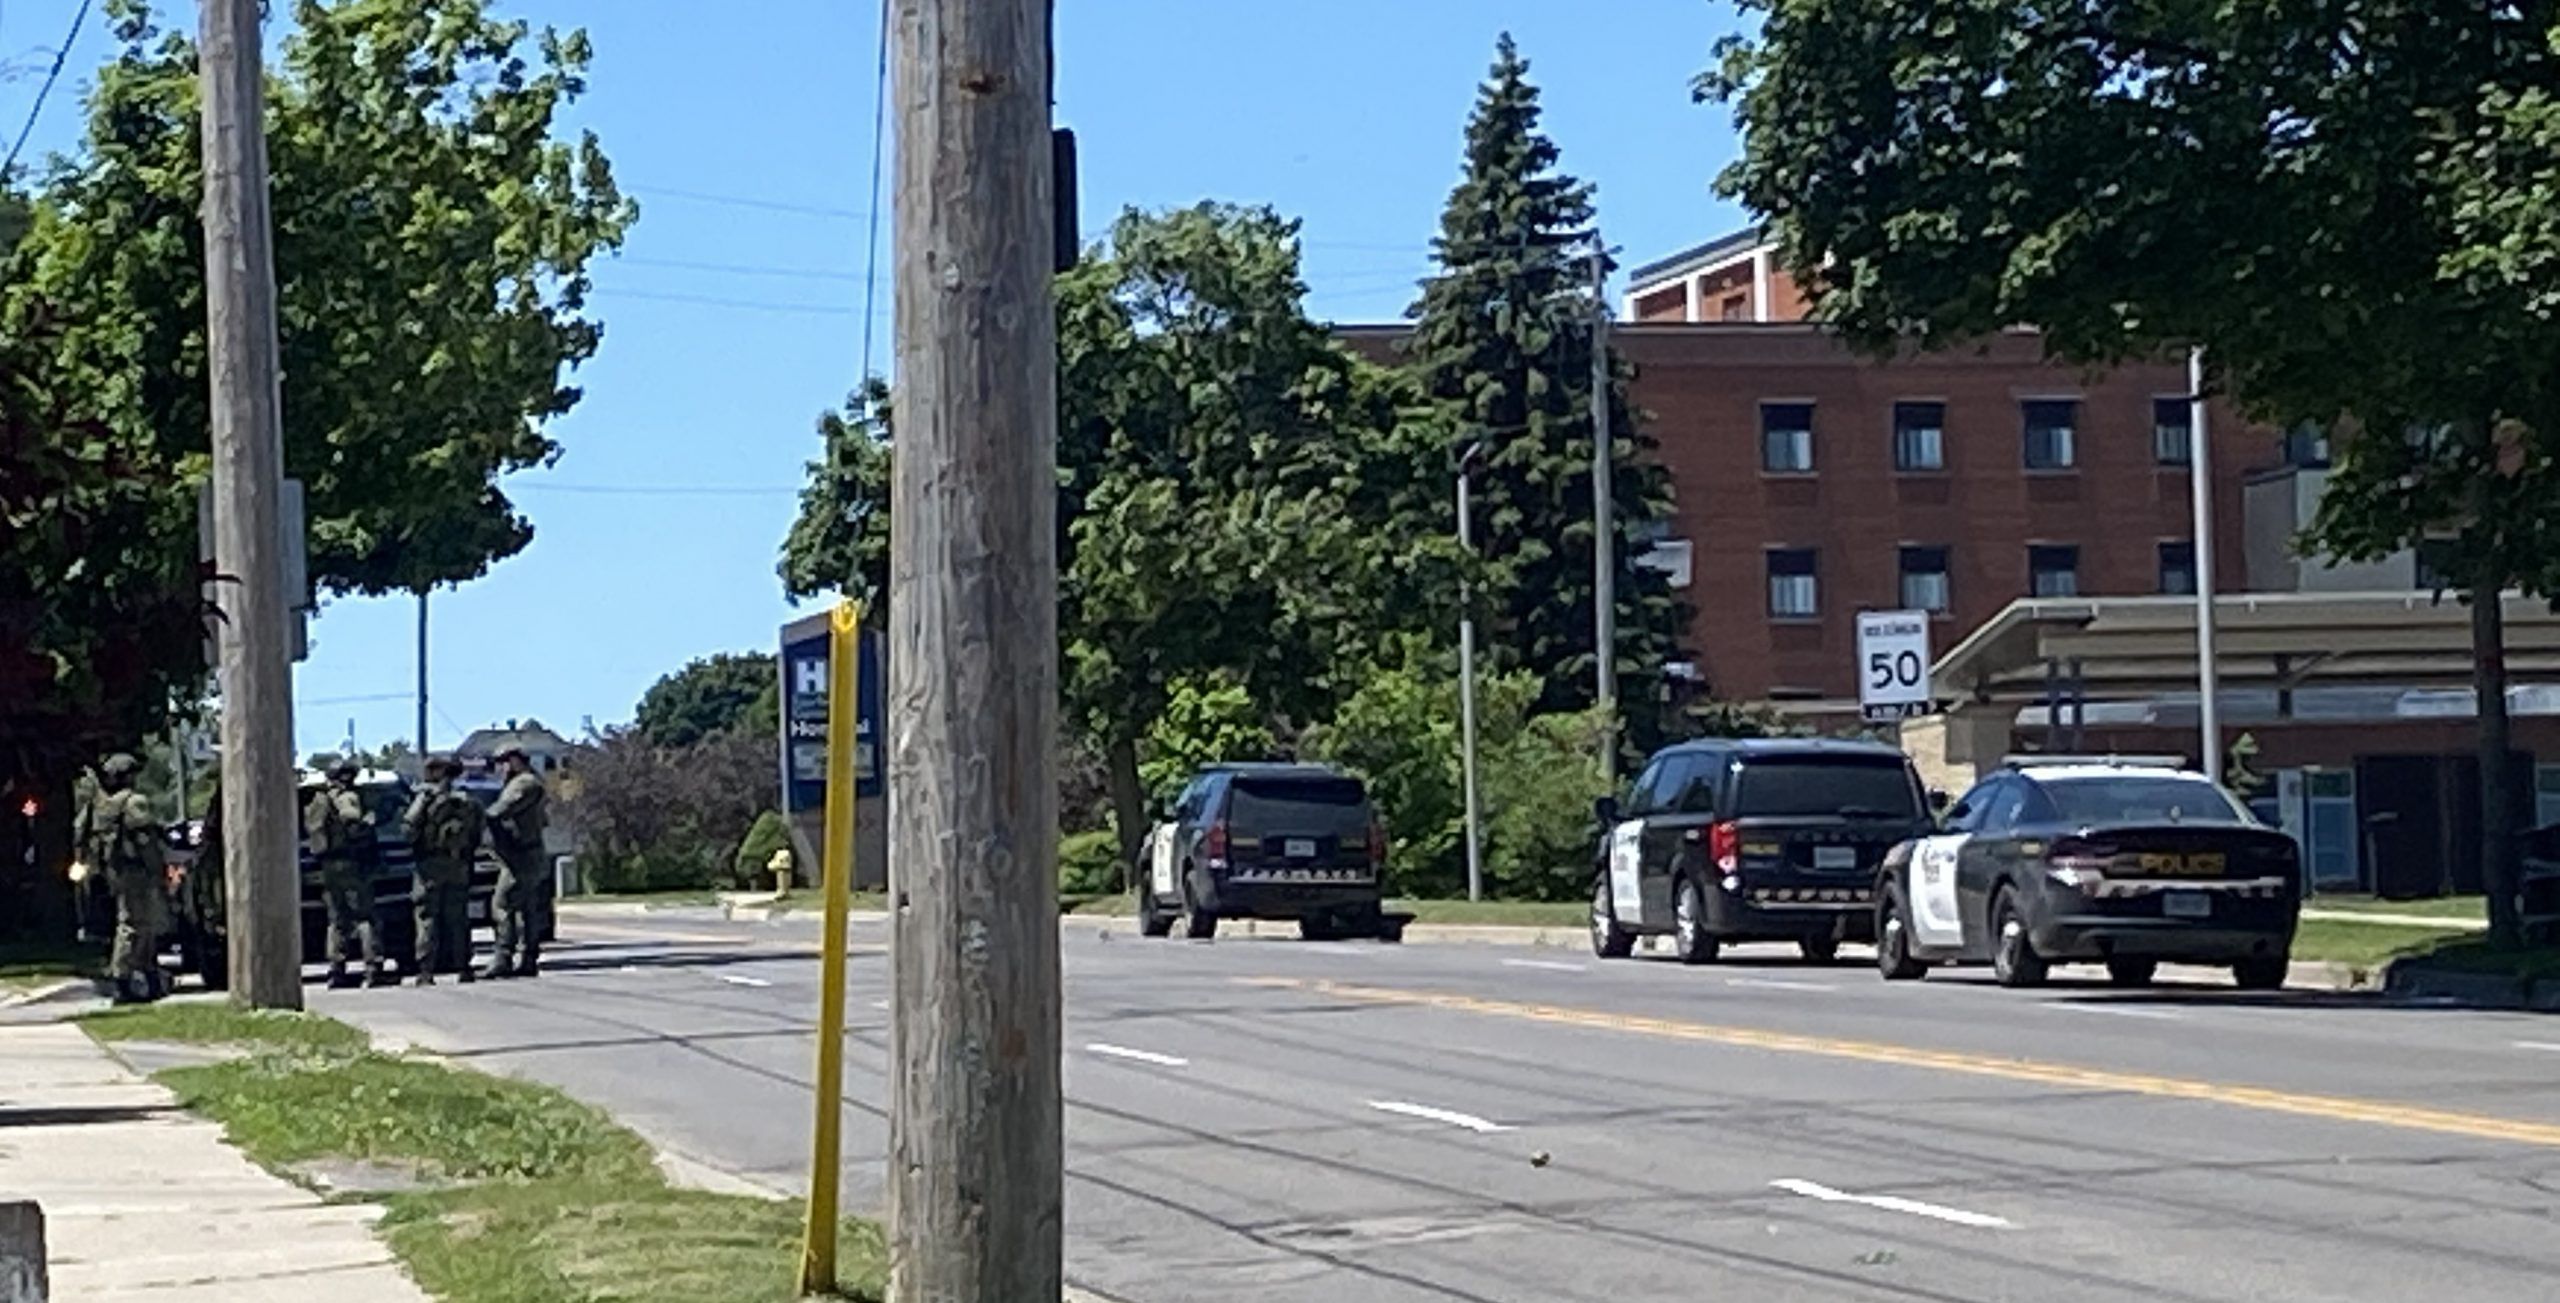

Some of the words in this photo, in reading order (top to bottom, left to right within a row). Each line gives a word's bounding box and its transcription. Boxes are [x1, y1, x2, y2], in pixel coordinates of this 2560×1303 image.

[797, 660, 827, 693] H
[1870, 649, 1920, 689] 50
[2140, 852, 2226, 875] POLICE
